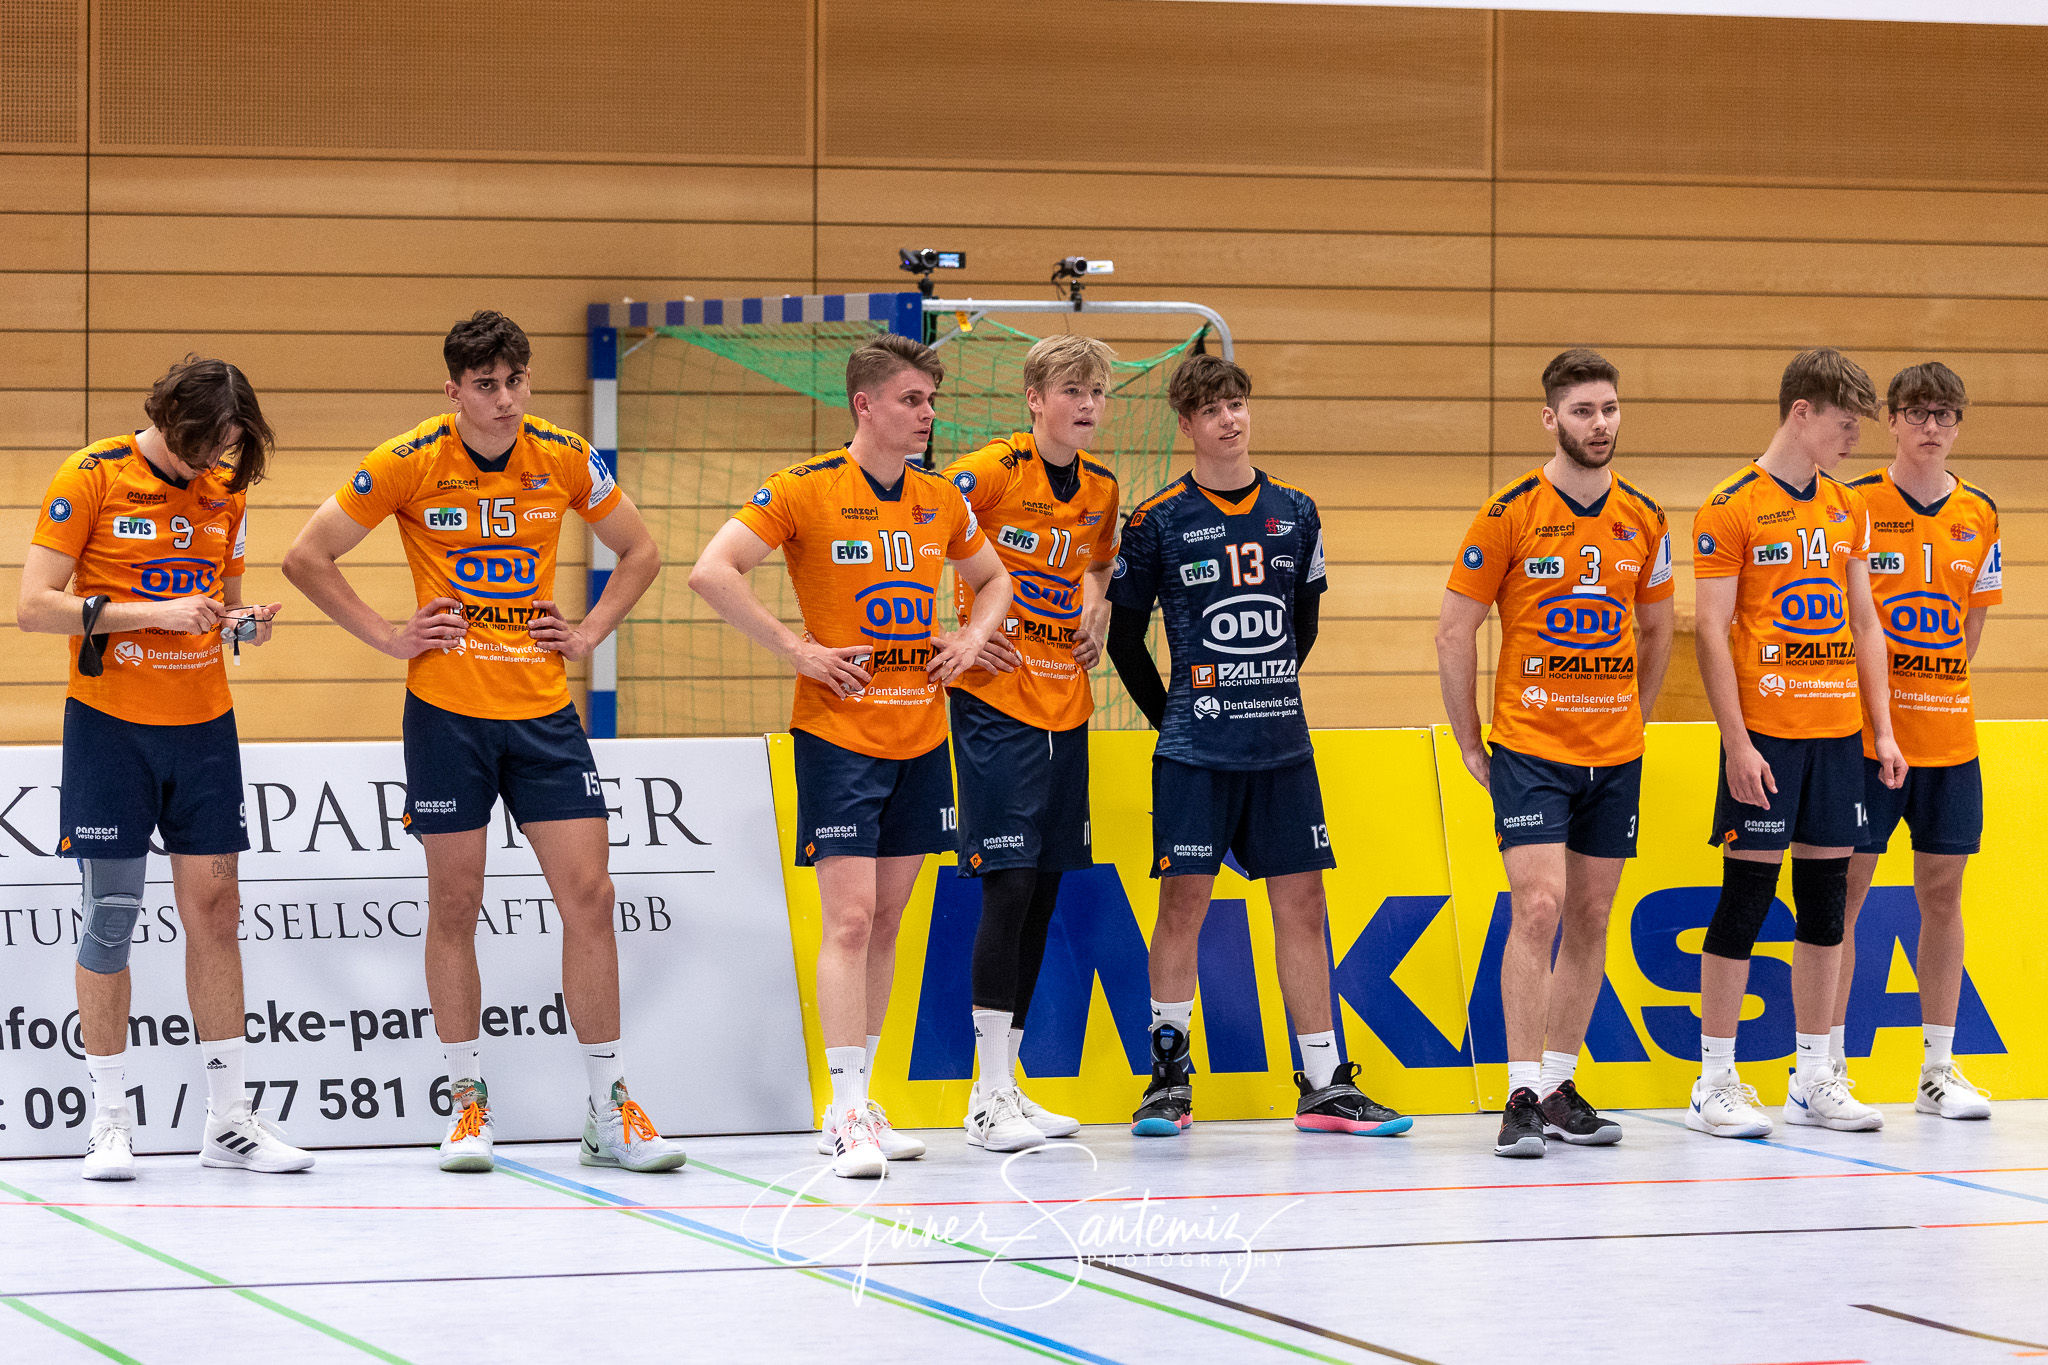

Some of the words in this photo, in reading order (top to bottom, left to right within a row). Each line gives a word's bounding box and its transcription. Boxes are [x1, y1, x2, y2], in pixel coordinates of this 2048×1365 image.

[437, 477, 479, 490] panzeri
[841, 506, 878, 516] panzeri
[1022, 500, 1054, 511] panzeri
[430, 513, 462, 526] EVIS
[478, 498, 516, 538] 15
[1757, 508, 1796, 524] panzeri
[119, 521, 151, 536] EVIS
[1536, 522, 1575, 536] panzeri
[1874, 518, 1914, 529] panzeri
[170, 515, 194, 549] 9
[1182, 523, 1226, 541] panzeri
[1187, 536, 1203, 544] veste
[1210, 532, 1226, 540] sport
[1003, 531, 1035, 550] EVIS
[1047, 526, 1072, 568] 11
[837, 546, 868, 560] EVIS
[878, 530, 914, 572] 10
[1758, 547, 1788, 562] EVIS
[1796, 528, 1830, 569] 14
[1225, 542, 1265, 586] 13
[1276, 560, 1294, 568] max
[1529, 562, 1560, 574] EVIS
[1579, 544, 1601, 586] 3
[1620, 564, 1640, 572] max
[1870, 558, 1900, 570] EVIS
[1922, 542, 1932, 584] 1
[1956, 563, 1976, 574] max
[455, 558, 536, 584] ODU
[1185, 565, 1214, 582] EVIS
[141, 568, 215, 594] ODU
[866, 598, 934, 626] ODU
[1781, 594, 1844, 621] ODU
[1210, 610, 1282, 640] ODU
[1546, 608, 1622, 636] ODU
[1891, 606, 1960, 636] ODU
[145, 628, 169, 636] HOCH
[1024, 634, 1044, 644] HOCH
[470, 639, 532, 654] Dentalservice
[148, 649, 208, 660] Dentalservice
[1218, 660, 1296, 680] PALITZA
[1549, 656, 1634, 672] PALITZA
[1549, 672, 1572, 680] HOCH
[1893, 670, 1916, 678] HOCH
[1244, 678, 1260, 686] UND
[1789, 679, 1844, 688] Dentalservice
[868, 686, 925, 696] Dentalservice
[1551, 692, 1614, 704] Dentalservice
[1617, 694, 1632, 702] Gust
[1894, 690, 1954, 704] Dentalservice
[1955, 694, 1970, 704] Gust
[1224, 698, 1282, 710] Dentalservice
[1284, 696, 1298, 706] Gust
[582, 771, 600, 796] 15
[415, 798, 456, 808] panzeri
[440, 806, 456, 814] sport
[240, 802, 247, 828] 9
[940, 807, 956, 832] 10
[1504, 812, 1543, 826] panzeri
[816, 824, 857, 836] panzeri
[1528, 820, 1544, 828] sport
[1627, 815, 1636, 838] 3
[1745, 819, 1785, 828] panzeri
[76, 826, 118, 836] panzeri
[102, 834, 118, 842] sport
[841, 831, 858, 839] sport
[1084, 821, 1090, 846] 11
[1311, 824, 1330, 850] 13
[983, 833, 1024, 846] panzeri
[1008, 840, 1024, 848] sport
[1174, 844, 1212, 852] panzeri
[907, 863, 2008, 1080] MIKASA
[24, 1084, 147, 1130] 091
[171, 1084, 188, 1128] /
[319, 1077, 405, 1120] 581
